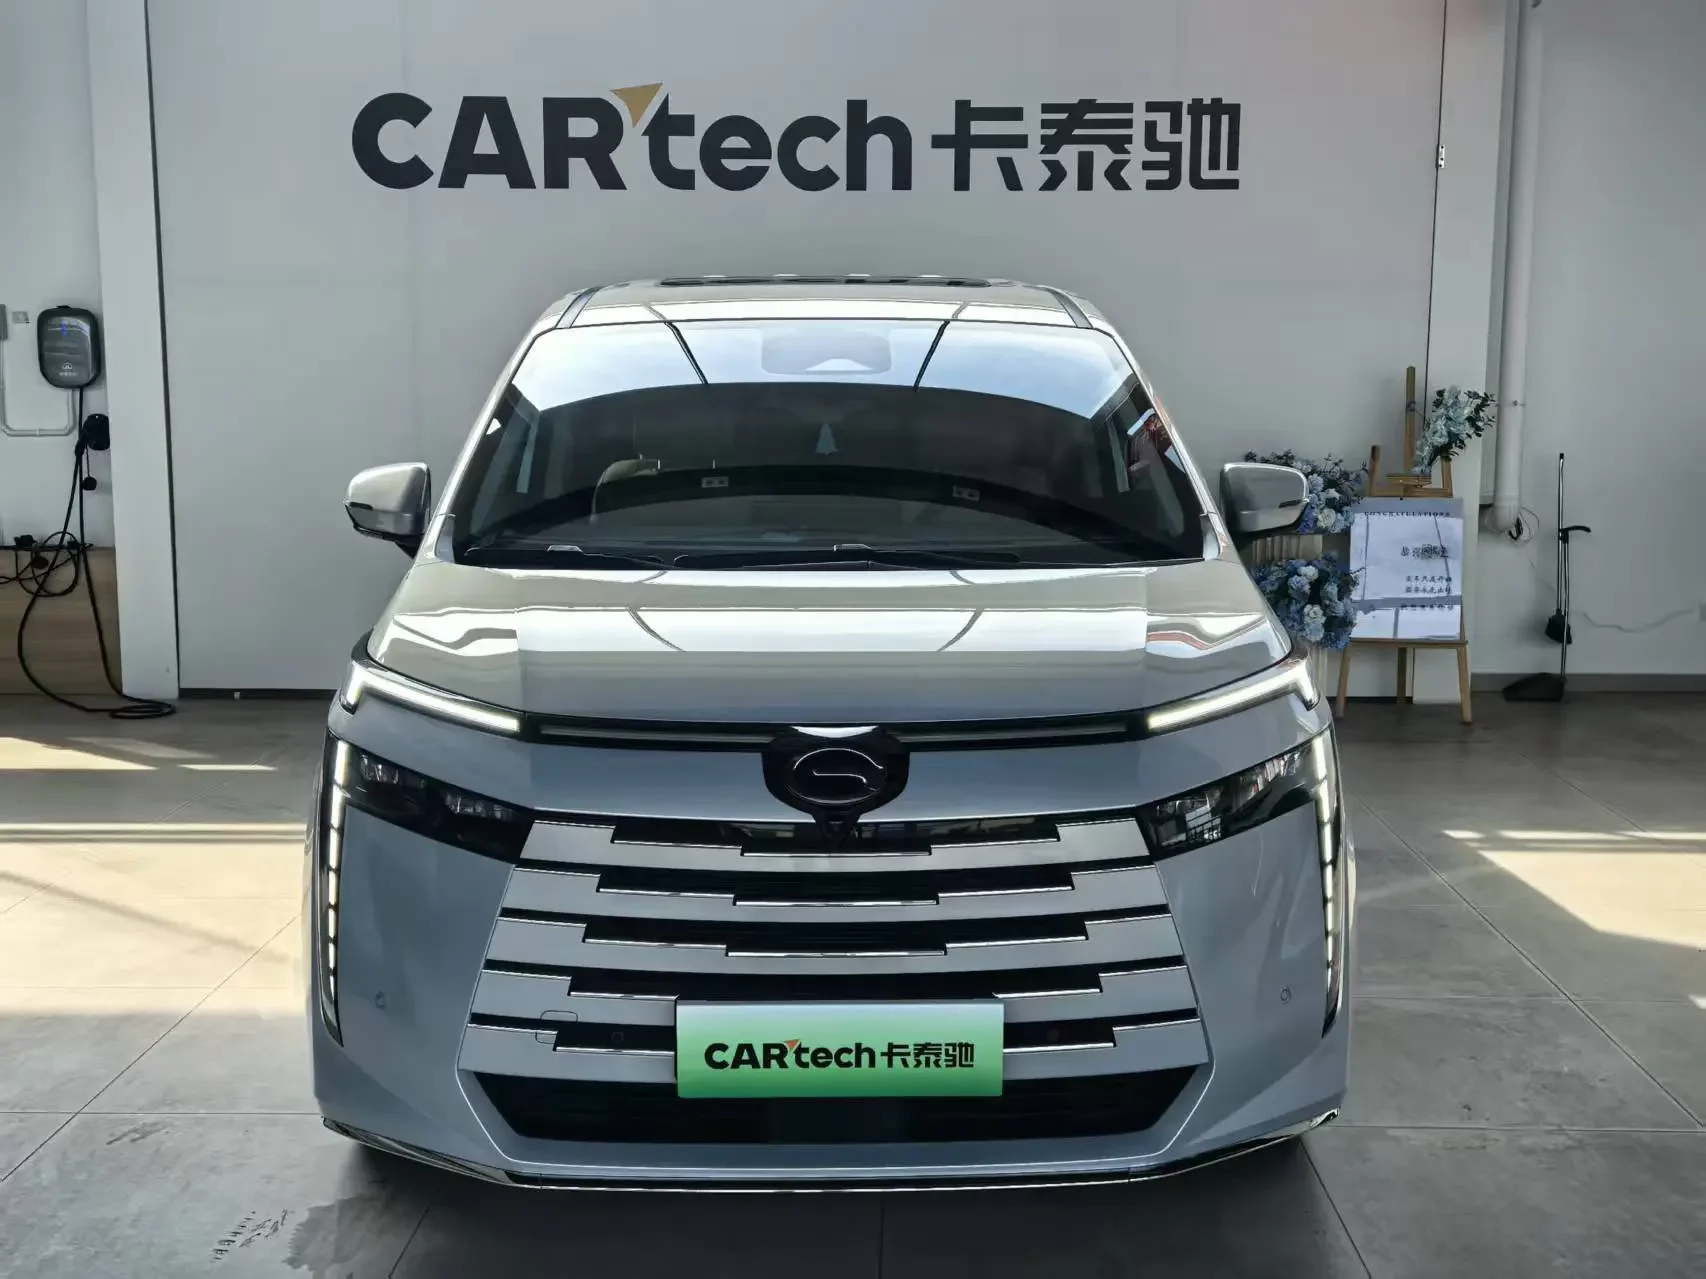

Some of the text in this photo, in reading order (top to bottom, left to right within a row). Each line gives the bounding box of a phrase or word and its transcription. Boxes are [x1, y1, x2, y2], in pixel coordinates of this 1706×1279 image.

[931, 98, 1241, 192] 卡泰驰
[880, 1042, 975, 1069] 卡泰驰
